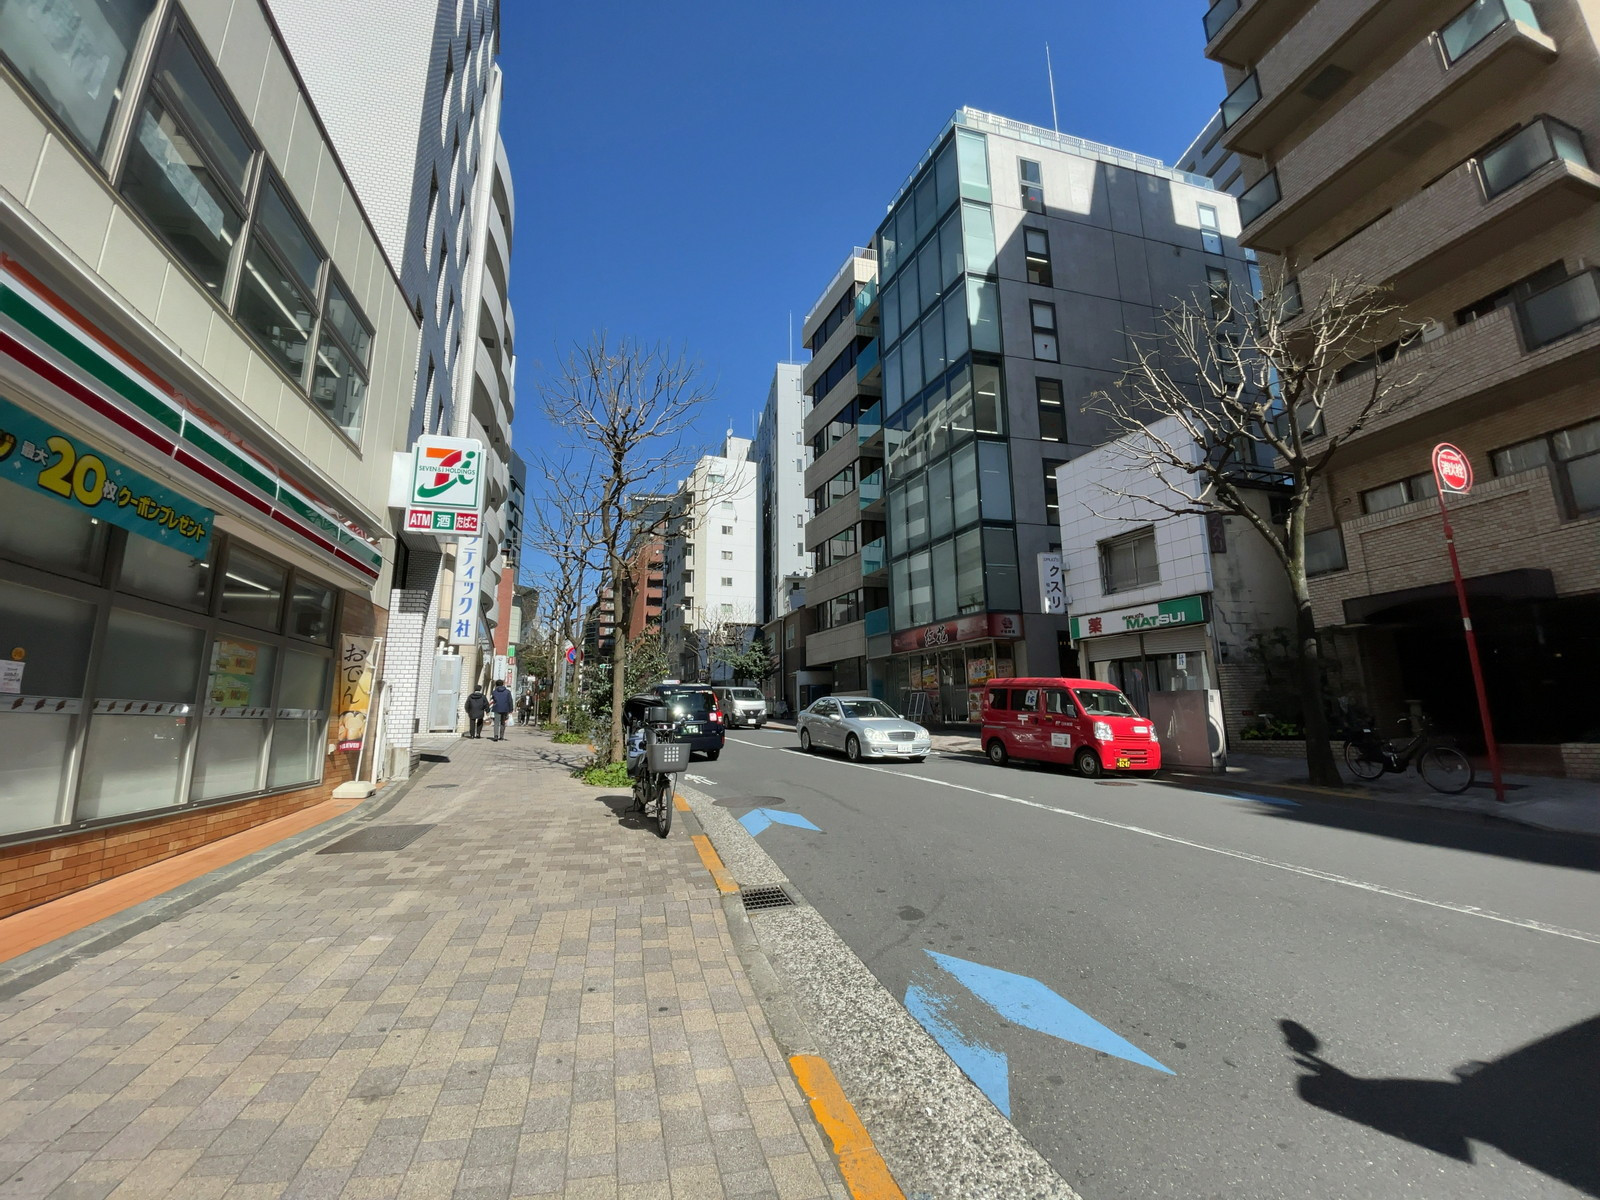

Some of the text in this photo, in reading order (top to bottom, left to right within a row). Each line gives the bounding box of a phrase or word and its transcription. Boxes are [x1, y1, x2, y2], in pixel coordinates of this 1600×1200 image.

[445, 467, 476, 476] HOLDINGS
[410, 512, 431, 527] ATM
[436, 514, 452, 528] 酒
[456, 515, 478, 529] たばこ
[1049, 565, 1062, 609] クスリ
[1088, 617, 1102, 634] 薬
[1126, 611, 1186, 630] MATSUI
[343, 643, 367, 705] おでん
